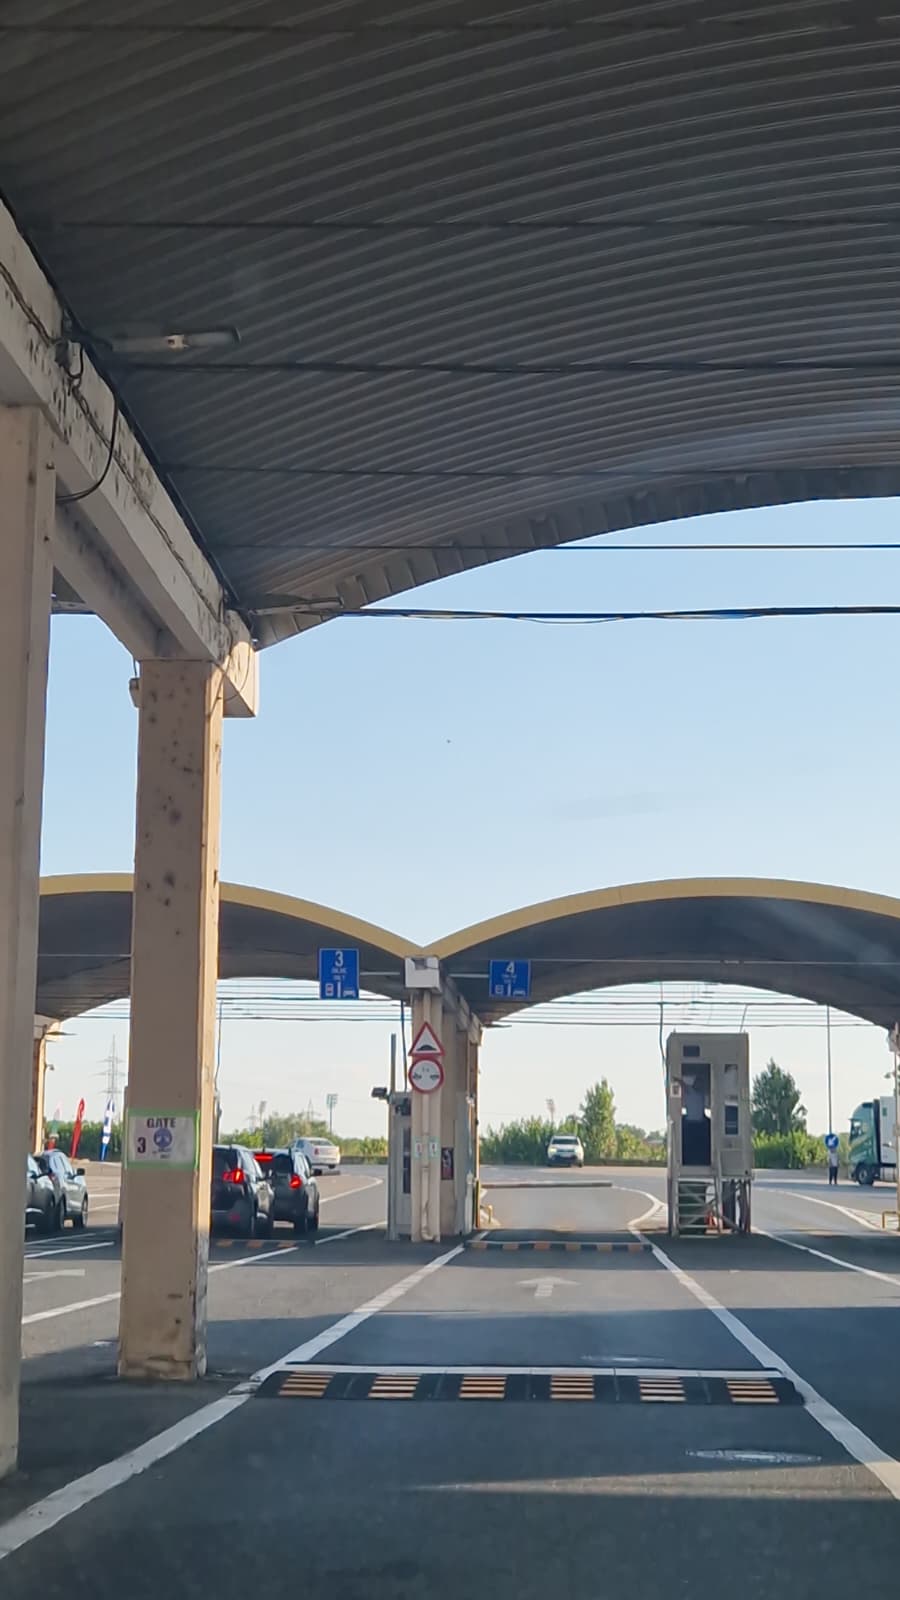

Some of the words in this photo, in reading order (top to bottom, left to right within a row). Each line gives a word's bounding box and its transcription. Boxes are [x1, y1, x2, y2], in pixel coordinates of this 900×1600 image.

[335, 951, 344, 967] 3
[506, 960, 515, 975] 4
[147, 1117, 176, 1128] GATE
[137, 1136, 146, 1154] 3
